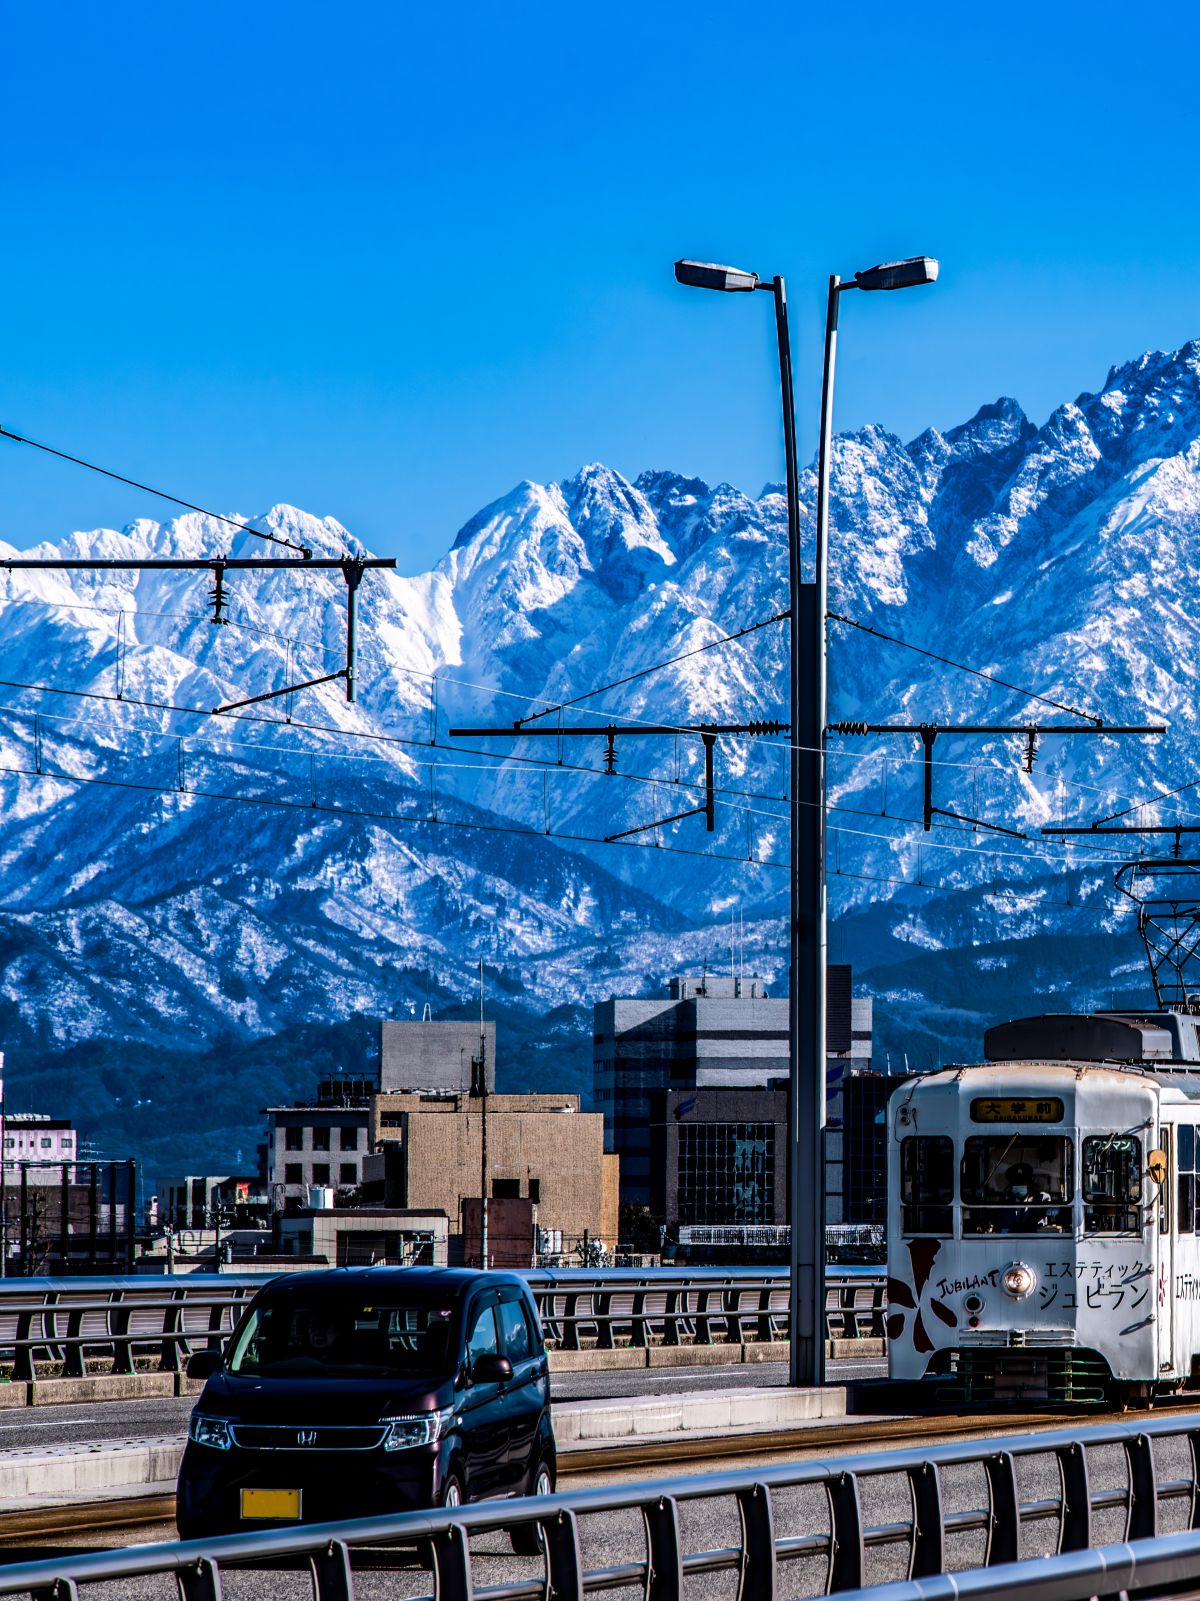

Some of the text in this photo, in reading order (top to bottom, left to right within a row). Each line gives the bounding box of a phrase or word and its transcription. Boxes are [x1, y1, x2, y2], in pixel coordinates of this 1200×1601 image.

[985, 1102, 1052, 1114] 大学前
[1092, 1140, 1131, 1150] ワンマン
[1044, 1261, 1144, 1279] エステティック
[935, 1269, 999, 1299] JUBILANT
[1038, 1281, 1149, 1310] ジュビラン
